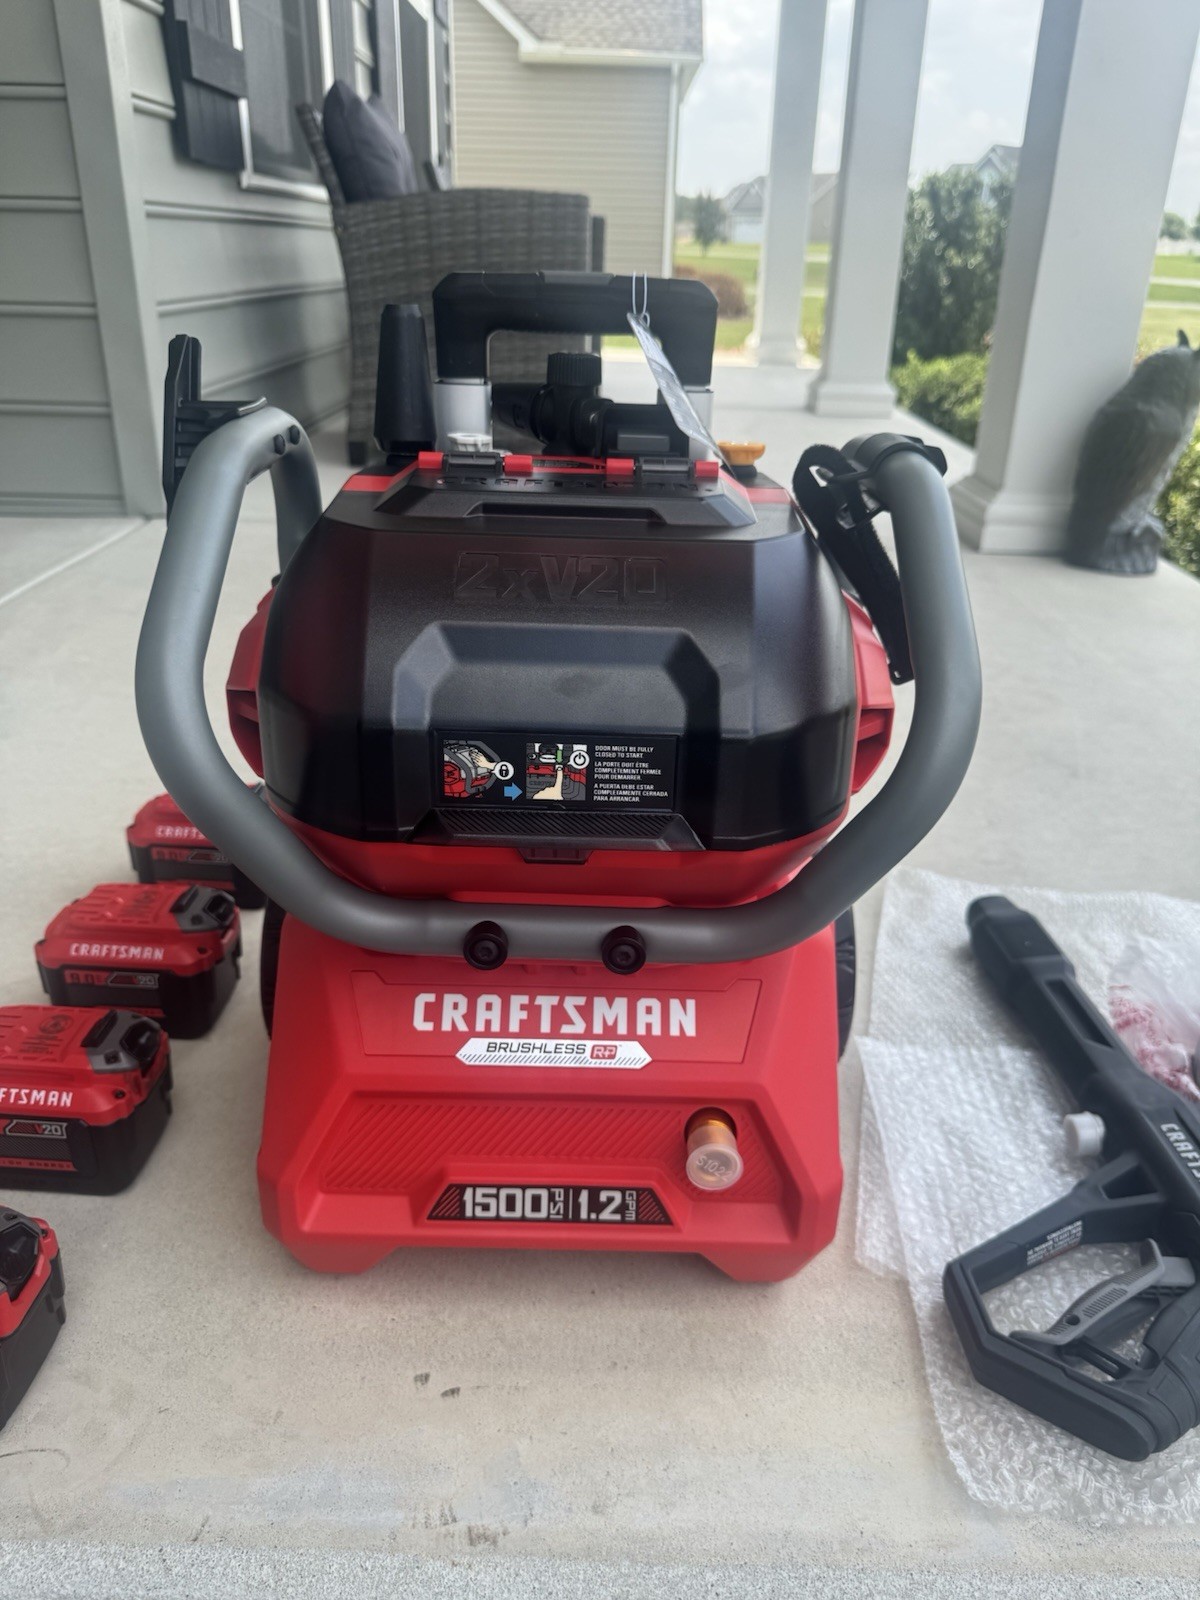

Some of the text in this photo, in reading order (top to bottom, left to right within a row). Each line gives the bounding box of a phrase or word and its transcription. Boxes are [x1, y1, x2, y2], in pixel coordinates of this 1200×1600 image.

[69, 943, 164, 961] CRAFTSMAN
[412, 992, 697, 1037] CRAFTSMAN
[486, 1042, 587, 1055] BRUSHLESS
[34, 1124, 62, 1136] V20
[463, 1187, 637, 1221] 1500 PSI 1.2 GPM
